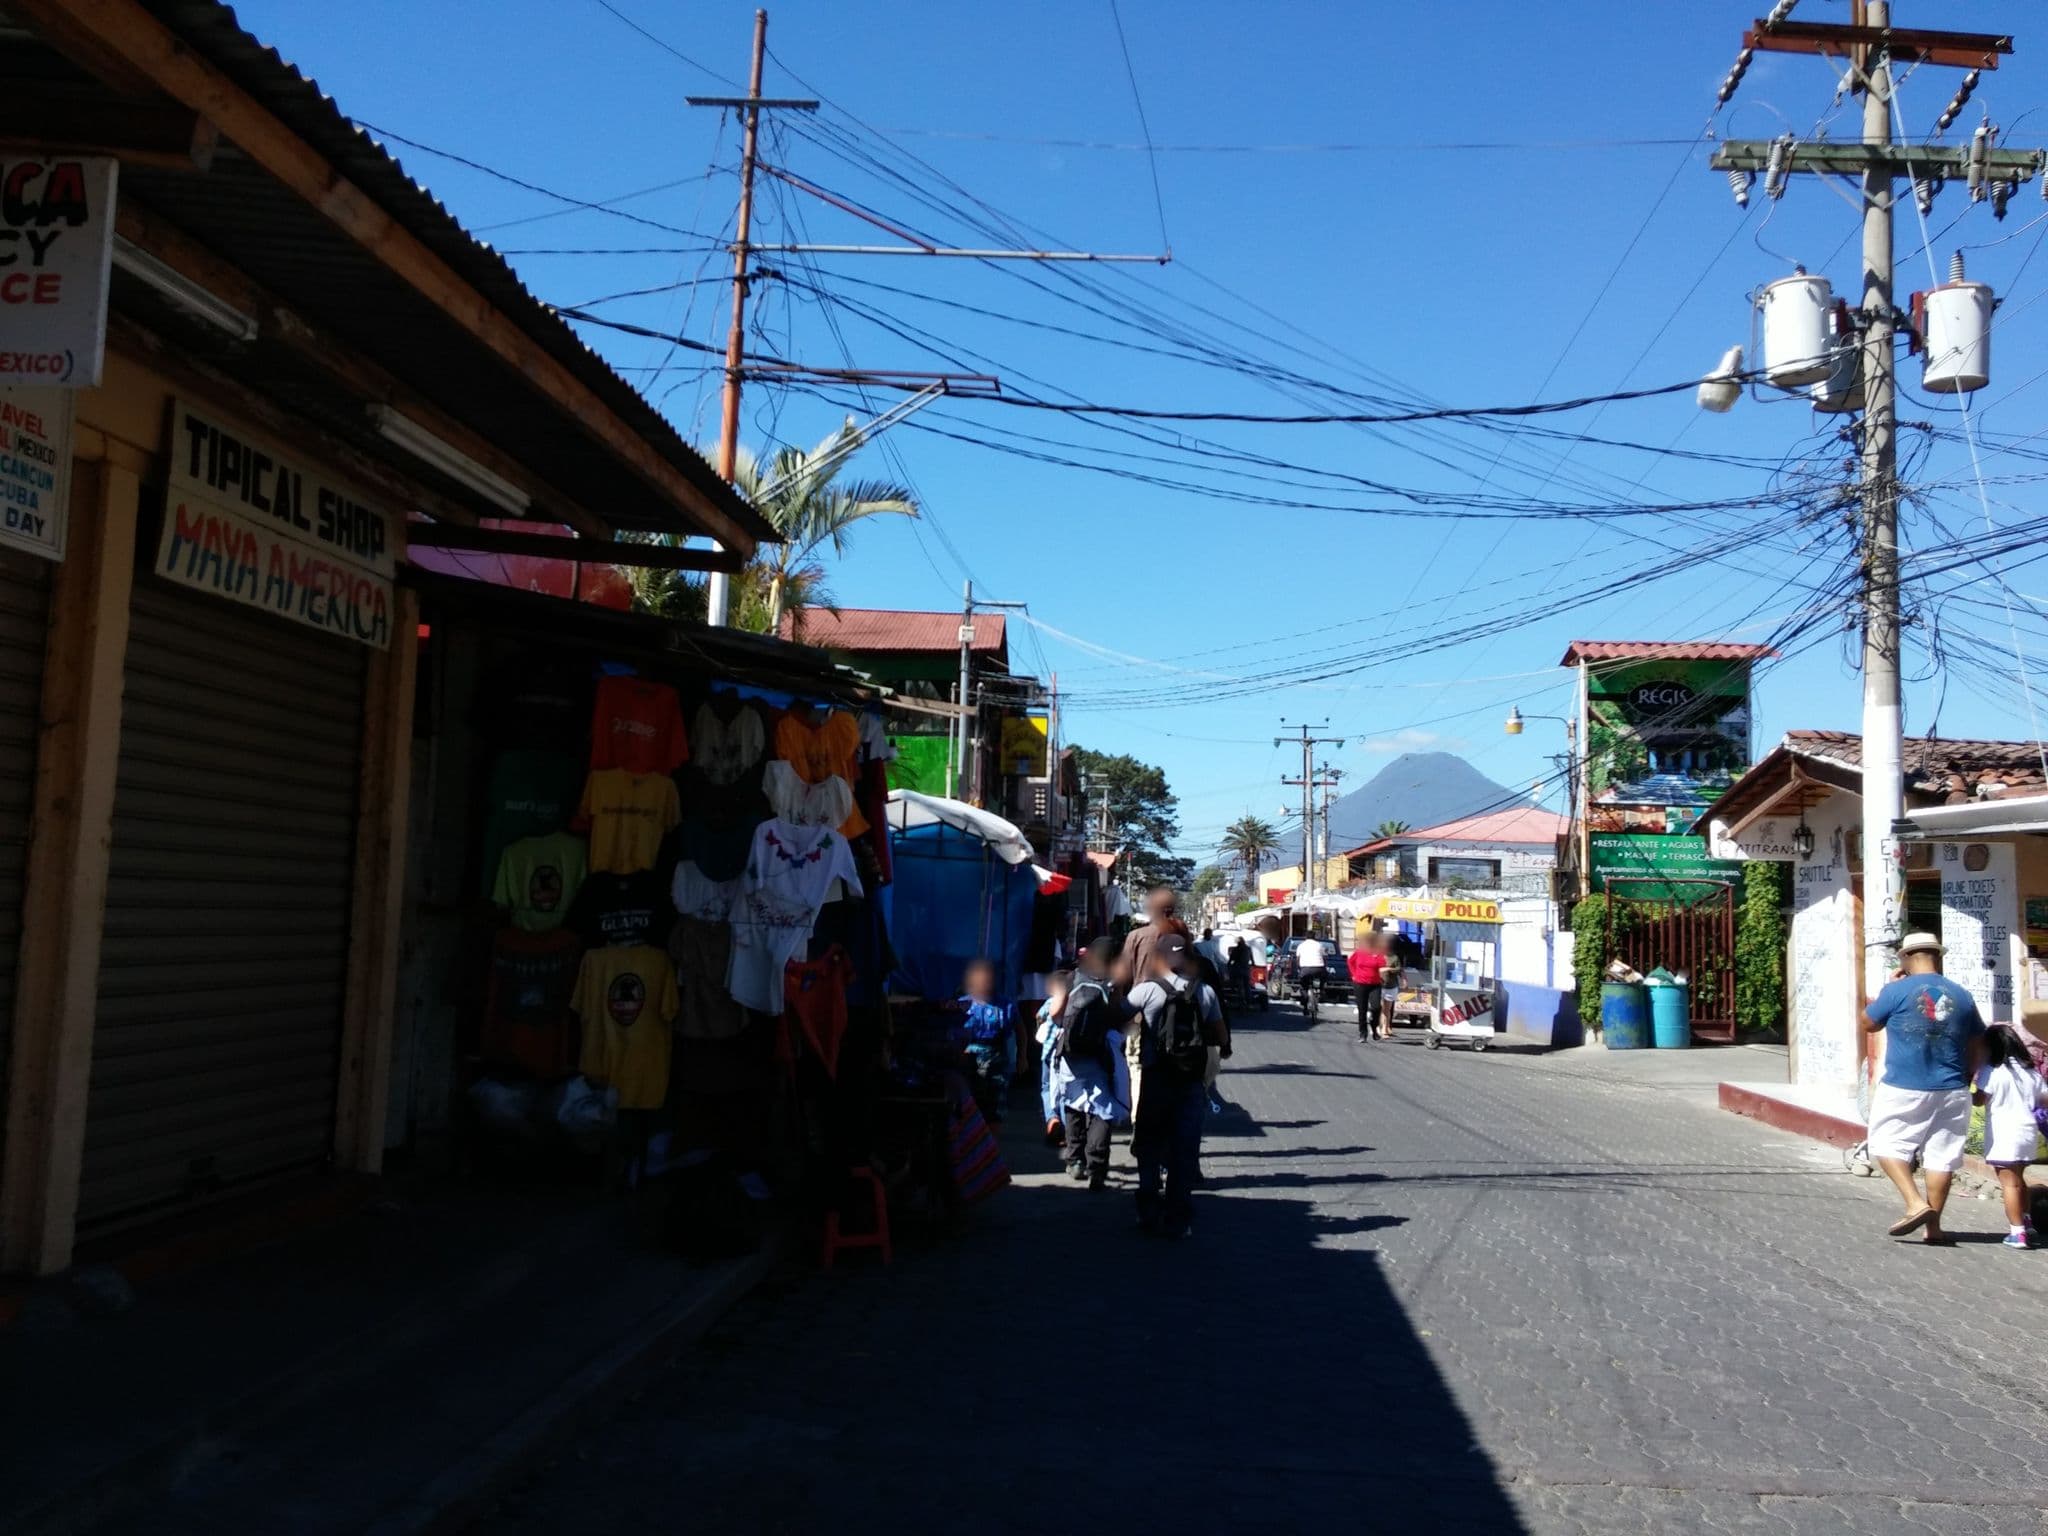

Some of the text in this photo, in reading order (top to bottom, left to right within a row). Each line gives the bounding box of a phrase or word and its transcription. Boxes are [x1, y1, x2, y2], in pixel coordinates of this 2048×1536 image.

[0, 162, 88, 226] CA
[0, 400, 48, 440] AVEL
[186, 414, 385, 560] TIPICAL SHOP
[6, 507, 44, 537] DAY
[167, 503, 387, 643] MAYA AMERICA
[1638, 688, 1689, 705] REGIS
[1669, 841, 1699, 849] AGUAS
[1669, 853, 1716, 861] TEMASCA
[1799, 864, 1832, 883] SHUTTLE
[1968, 879, 1996, 893] TICKETS
[1445, 903, 1498, 919] POLLO
